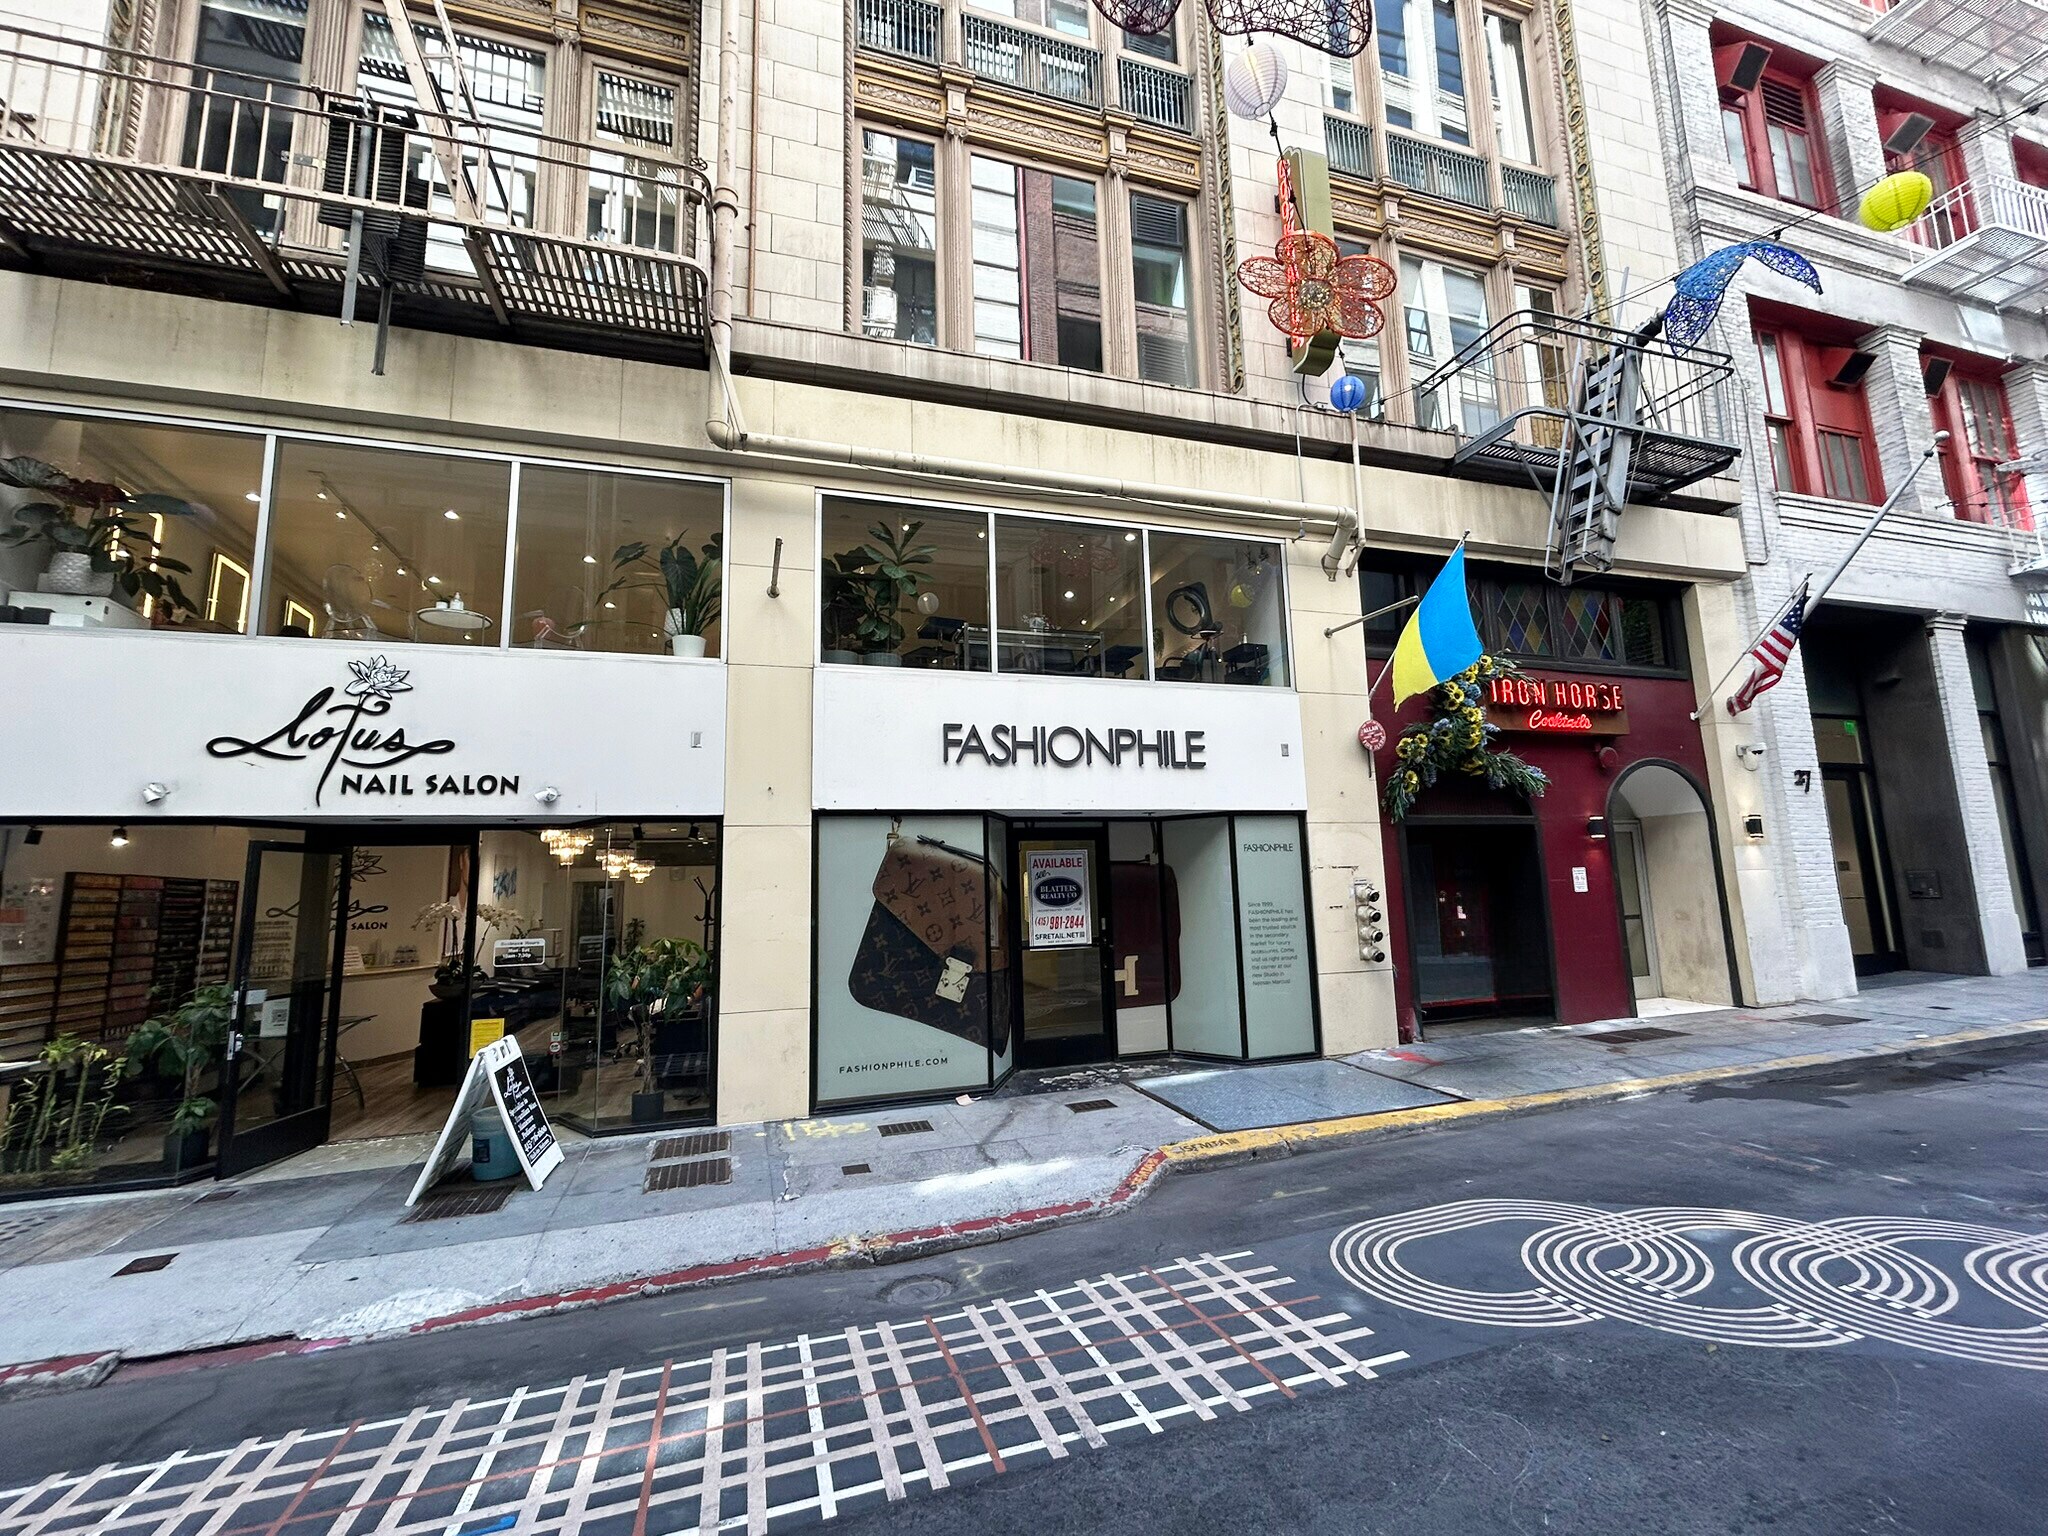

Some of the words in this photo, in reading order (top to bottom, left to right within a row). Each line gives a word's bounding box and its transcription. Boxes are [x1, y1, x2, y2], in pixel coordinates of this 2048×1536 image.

[1490, 678, 1546, 706] IRON
[1554, 681, 1623, 711] HORSE
[1528, 708, 1593, 730] Cocktails
[206, 686, 456, 807] Lotus
[943, 723, 1207, 770] FASHIONPHILE
[340, 774, 414, 795] NAIL
[425, 774, 520, 795] SALON
[1794, 769, 1811, 794] 27
[1243, 843, 1294, 852] FASHIONPHILE
[1032, 858, 1082, 869] AVAILABLE
[351, 921, 388, 931] SALON
[1050, 914, 1085, 930] 981-2844
[839, 1057, 949, 1074] FASHIONPHILE.COM
